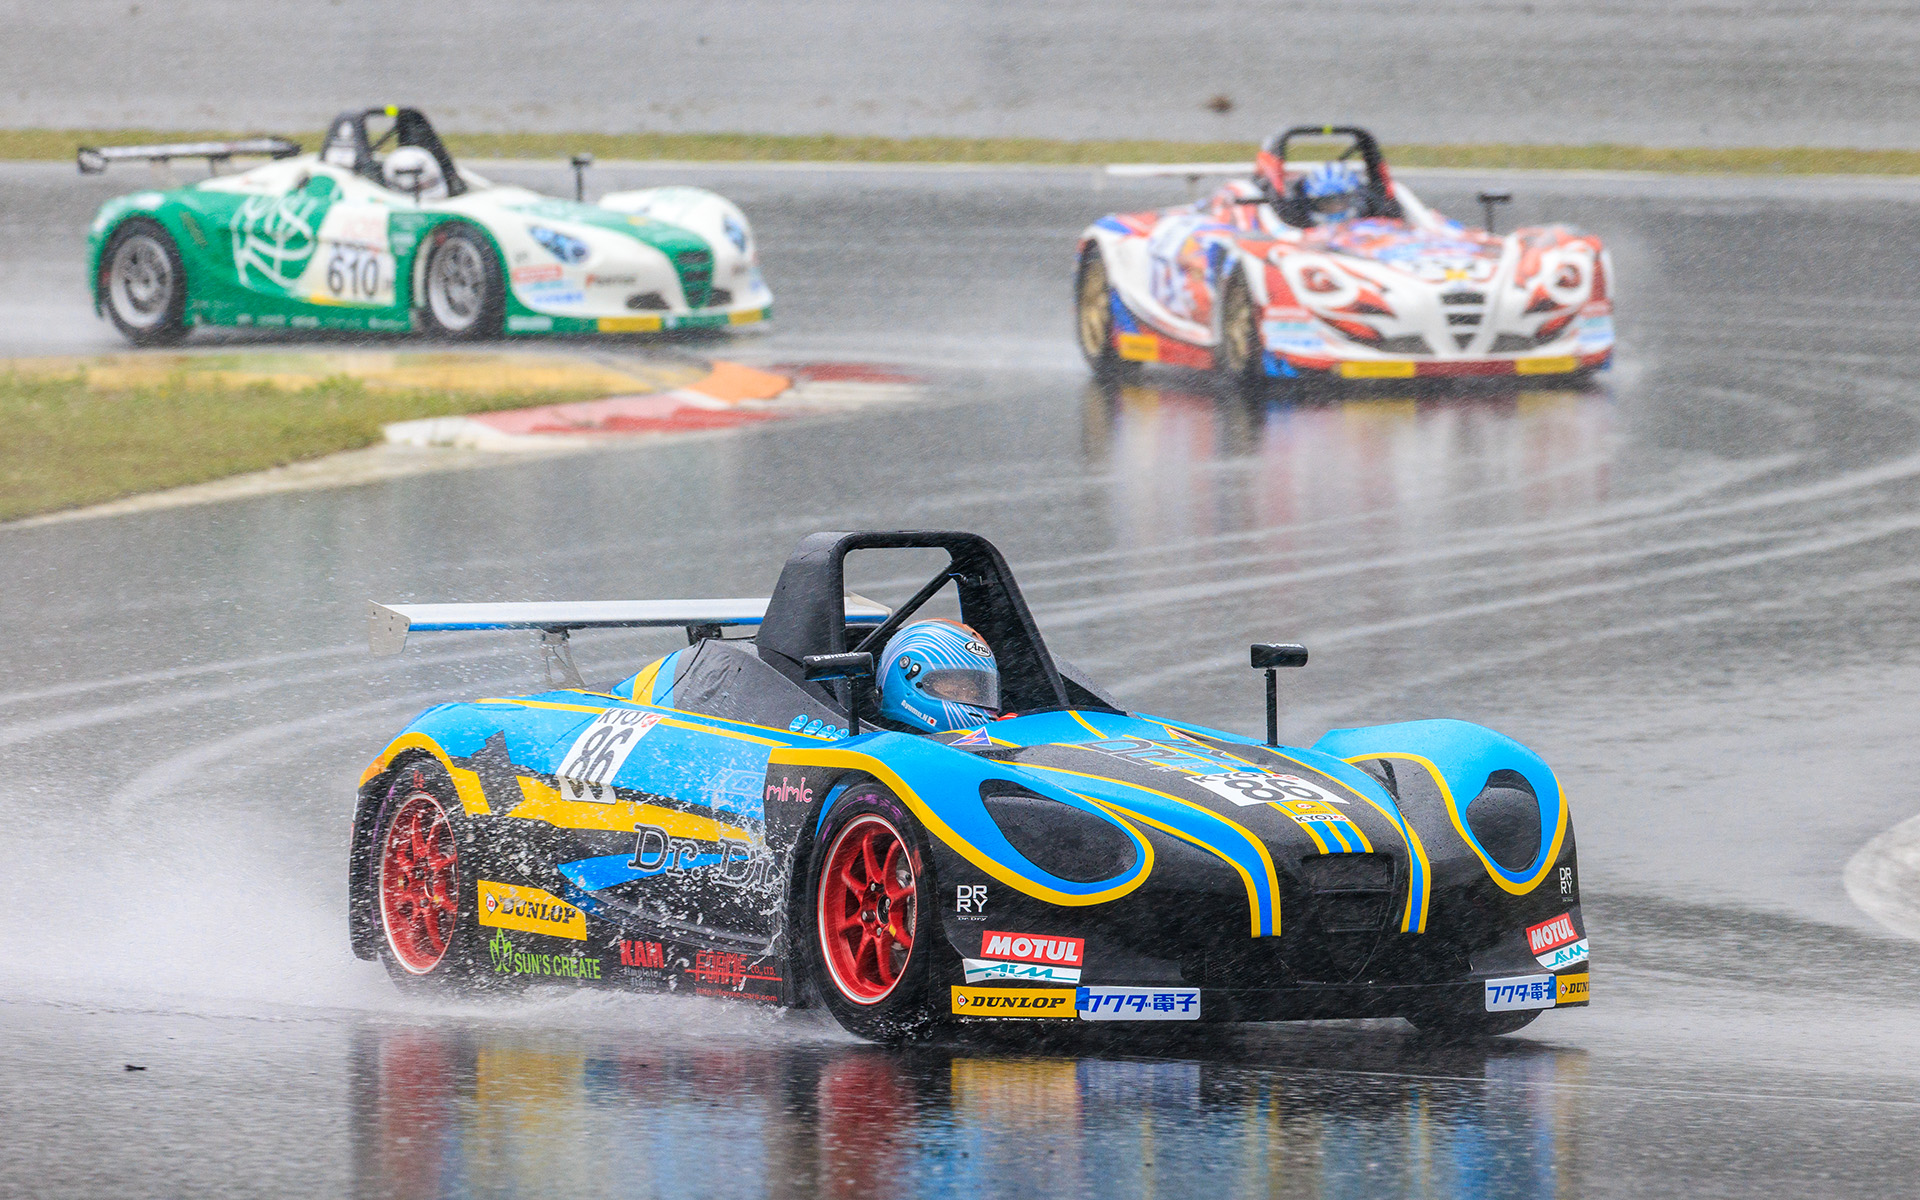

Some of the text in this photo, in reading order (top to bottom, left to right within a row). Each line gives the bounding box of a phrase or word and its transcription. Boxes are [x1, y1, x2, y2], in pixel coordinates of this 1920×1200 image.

[327, 255, 379, 297] 610
[565, 726, 634, 800] 86
[766, 776, 813, 803] mimic
[1225, 779, 1324, 801] 86
[627, 822, 701, 880] Dr.
[957, 885, 988, 899] DR
[957, 898, 988, 913] RY
[500, 896, 576, 924] DUNLOP
[1531, 918, 1575, 951] MOTUL
[620, 940, 664, 968] KAM
[985, 935, 1079, 962] MOTUL
[515, 953, 601, 979] SUN'S CREATE
[971, 996, 1066, 1008] DUNLOP
